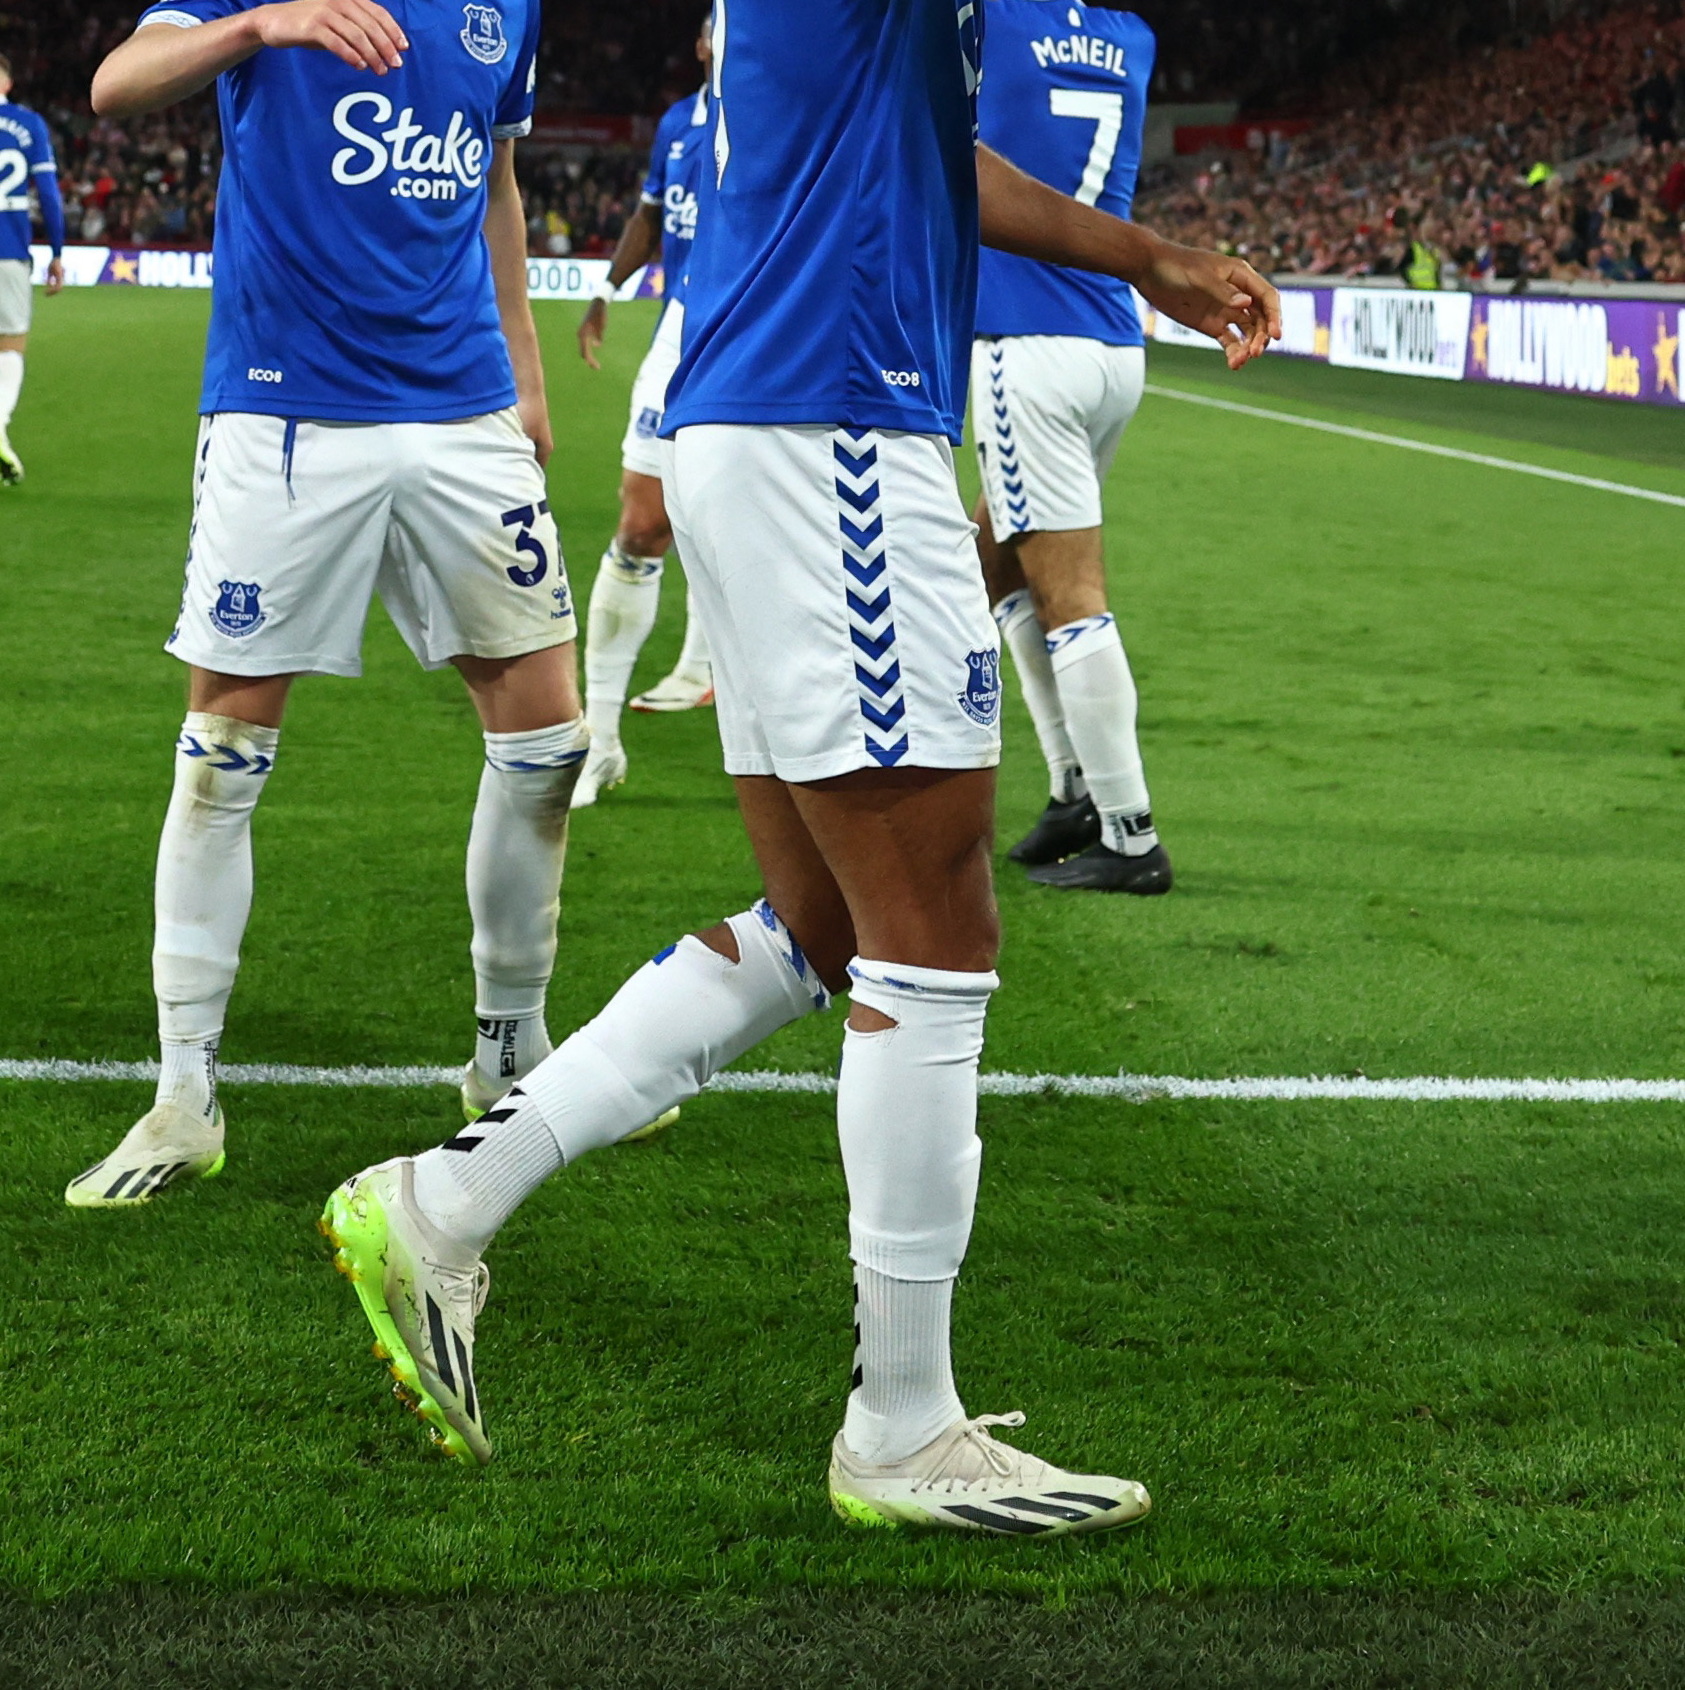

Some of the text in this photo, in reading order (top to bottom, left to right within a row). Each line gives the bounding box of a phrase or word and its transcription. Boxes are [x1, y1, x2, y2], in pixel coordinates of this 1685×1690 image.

[1030, 35, 1127, 77] McNEIL
[331, 91, 483, 188] Stake
[1049, 88, 1123, 207] 7
[390, 177, 457, 200] .com
[1487, 300, 1640, 397] HOLLYWOOD bets
[219, 609, 254, 621] Everton
